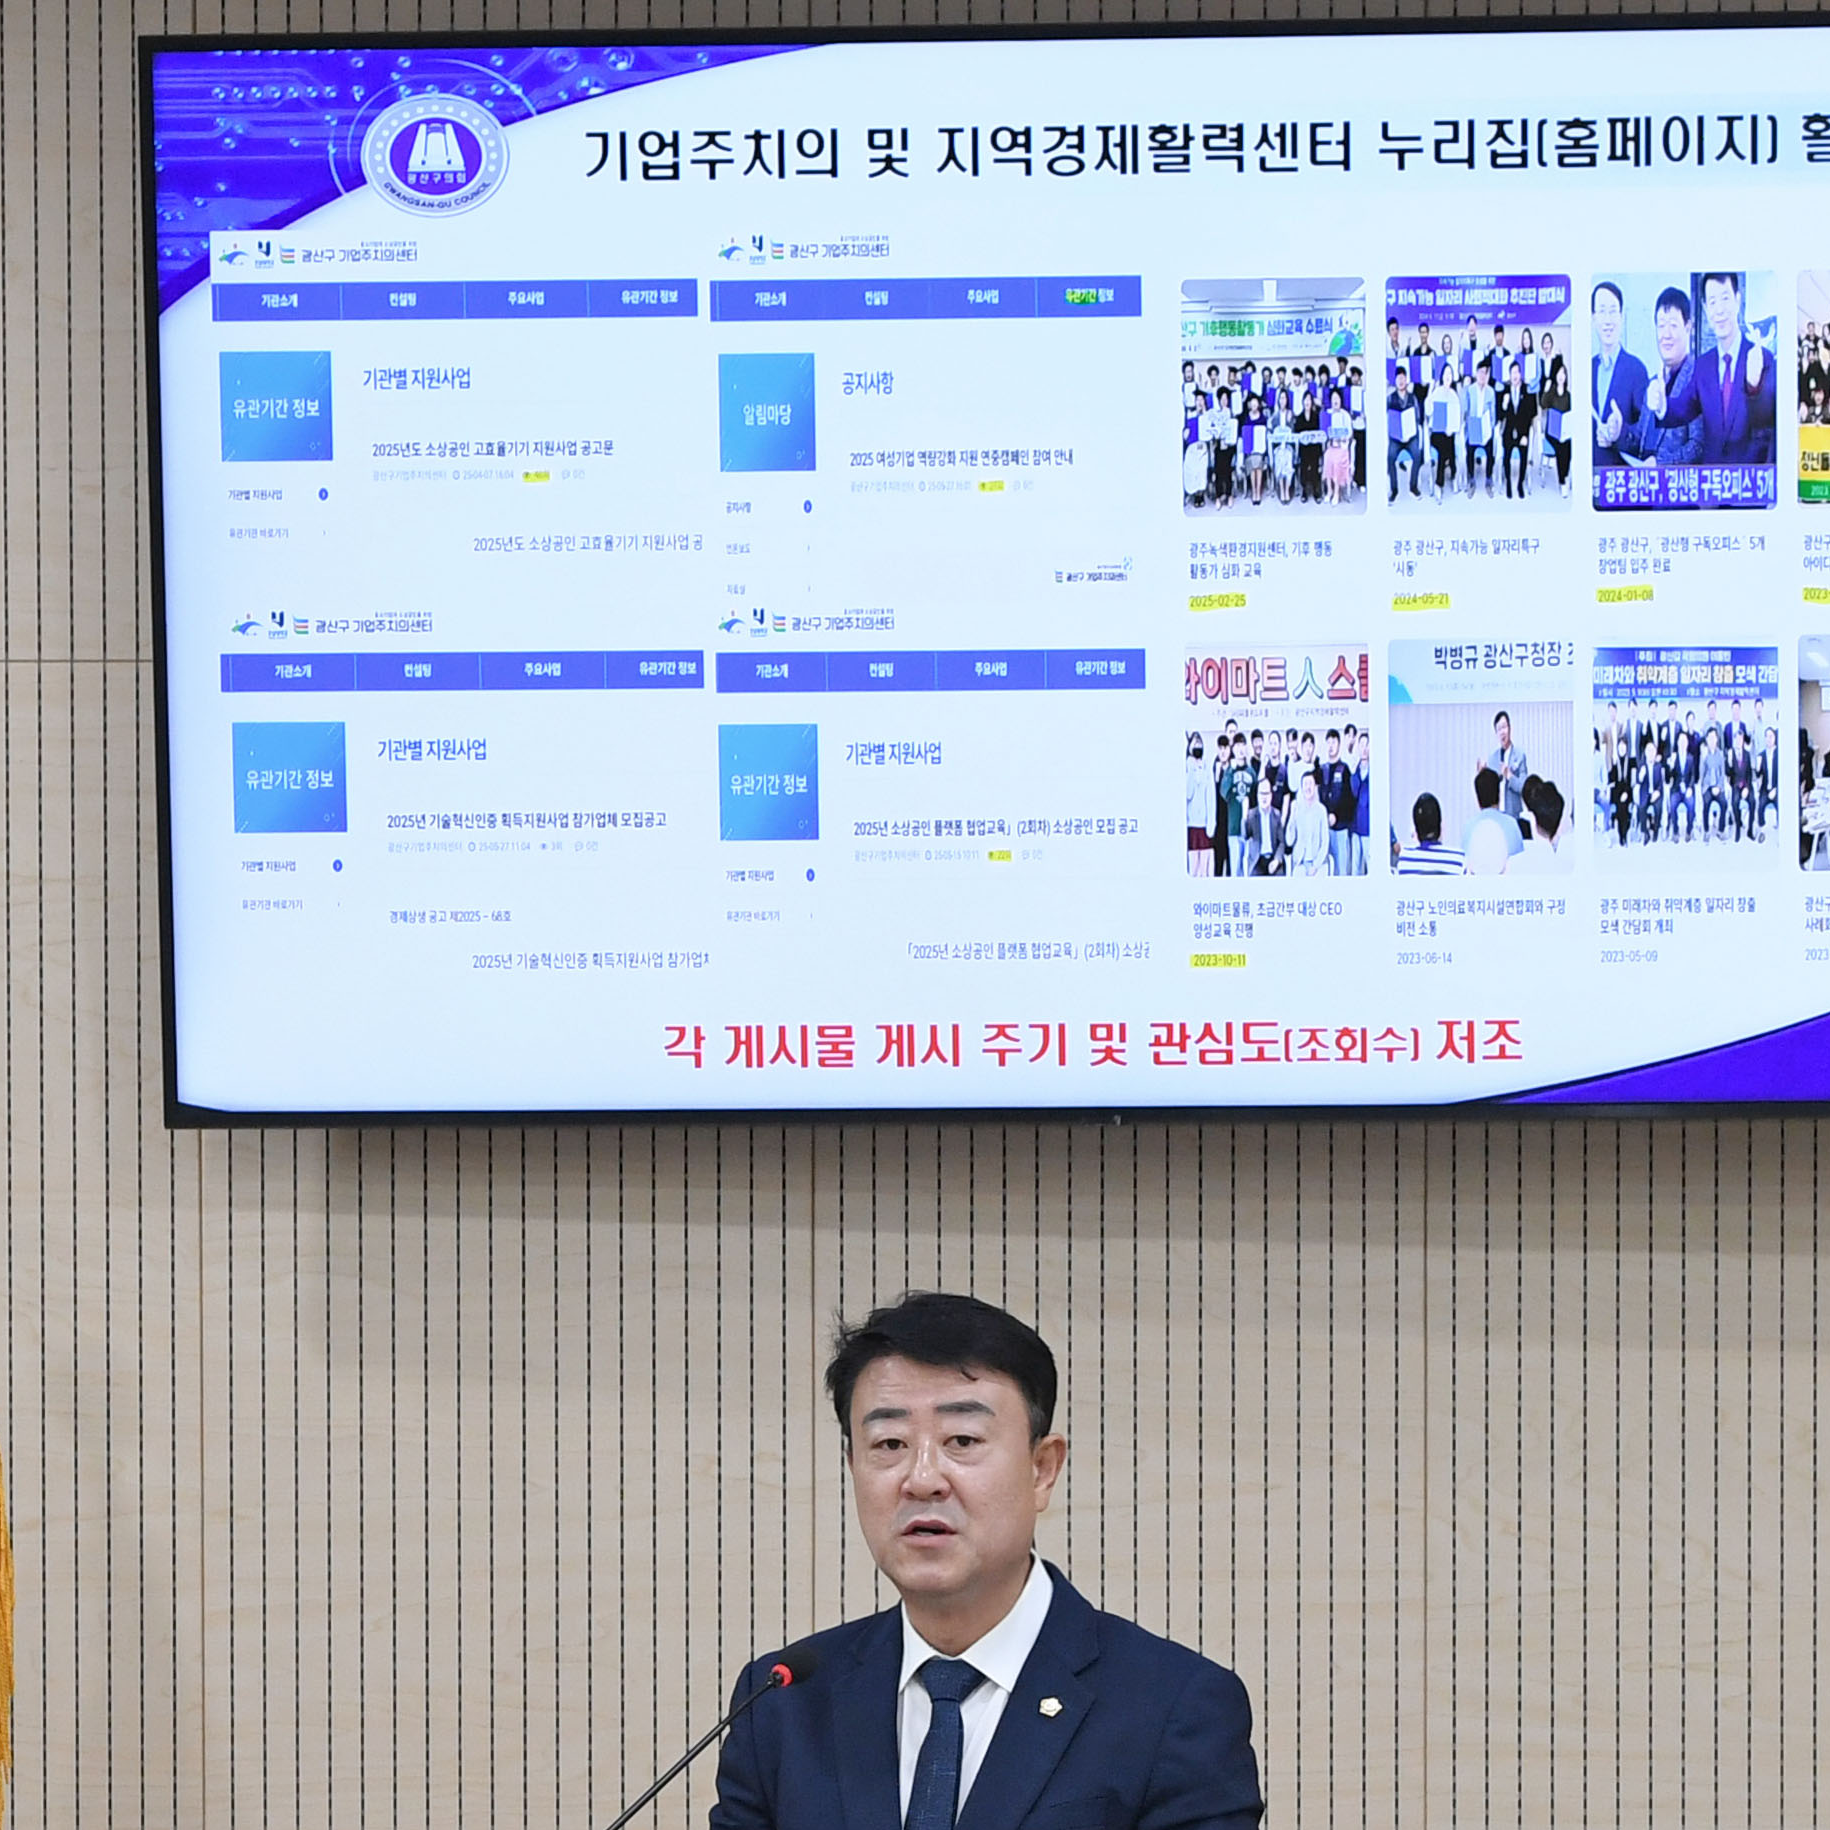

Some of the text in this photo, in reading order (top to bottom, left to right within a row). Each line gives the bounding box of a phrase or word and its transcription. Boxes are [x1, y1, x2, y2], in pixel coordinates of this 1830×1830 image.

[585, 127, 839, 181] 기업주치의
[867, 126, 910, 179] 및
[936, 122, 1351, 177] 지역경제활력센터
[302, 249, 418, 263] 광산구 기업주치의센터
[261, 293, 298, 308] 기관소개
[508, 290, 545, 305] 주요사업
[362, 366, 471, 390] 기관별 지원사업
[842, 371, 894, 395] 공지사항
[292, 398, 320, 418] 정보
[743, 404, 792, 426] 알림마당
[372, 440, 614, 457] 2025년도 소상공인 고효율기기 지원사업 공고문
[850, 452, 874, 467] 2025
[876, 451, 915, 468] 여성기업
[959, 450, 978, 467] 지원
[1032, 449, 1052, 466] 참여
[1054, 448, 1073, 465] 안내
[1605, 469, 1626, 503] 광주
[473, 535, 525, 552] 2025년도
[528, 534, 576, 552] 소상공인
[579, 533, 639, 551] 고효율기기
[641, 533, 690, 551] 지원사업
[1292, 541, 1310, 557] 기후
[1394, 540, 1411, 556] 광주
[1451, 539, 1487, 555] 지속가능
[1492, 538, 1540, 555] 일자리특구
[1598, 537, 1616, 553] 광주
[1749, 536, 1765, 551] 5개
[1189, 562, 1262, 579] 활동가 심화 교육
[1599, 558, 1670, 575] 창업팀 입주 완료
[1394, 593, 1449, 605] 2024-05-21
[315, 617, 433, 634] 광산구 기업주치의센터
[791, 615, 895, 631] 광산구 기업주치의센터
[1434, 644, 1478, 670] 박병규
[1483, 642, 1562, 668] 광산구청장
[274, 663, 312, 679] 기관소개
[524, 662, 561, 677] 주요사업
[678, 661, 697, 676] 정보
[755, 663, 789, 679] 기관소개
[974, 661, 1007, 677] 주요사업
[1109, 660, 1126, 675] 정보
[377, 739, 487, 761] 기관별 지원사업
[845, 742, 942, 766] 기관별 지원사업
[306, 769, 334, 790] 정보
[783, 774, 808, 795] 정보
[387, 811, 667, 830] 2025년 기술혁신인증 획득지원사업 참가업체 모집공고
[853, 817, 1138, 838] 2025년 소상공인 플랫폼 (2회차) 소상공인 모집 공고
[1256, 901, 1295, 918] 초급간부
[1298, 901, 1317, 917] 대상
[1320, 901, 1343, 916] CEO
[1396, 900, 1425, 916] 광산구
[1547, 899, 1566, 915] 구정
[1600, 898, 1620, 915] 광주
[1622, 898, 1661, 915] 미래차와
[1705, 897, 1734, 913] 일자리
[1193, 922, 1254, 939] 양성교육 진행
[1396, 921, 1437, 937] 비전 소통
[1600, 918, 1674, 936] 모색 간담회 개최
[952, 942, 1119, 960] 소상공인 플랫폼 (2회차)
[1397, 952, 1452, 965] 2023-06-14
[1600, 949, 1658, 963] 2023-05-09
[472, 952, 663, 969] 2025년 기술혁신인증 획득지원사업
[1193, 953, 1246, 967] 2023-10-11
[664, 1022, 705, 1069] 각
[723, 1021, 856, 1069] 게시물
[875, 1021, 961, 1069] 게시
[982, 1021, 1068, 1067] 주기
[1088, 1022, 1129, 1067] 및
[1435, 1016, 1524, 1065] 저조
